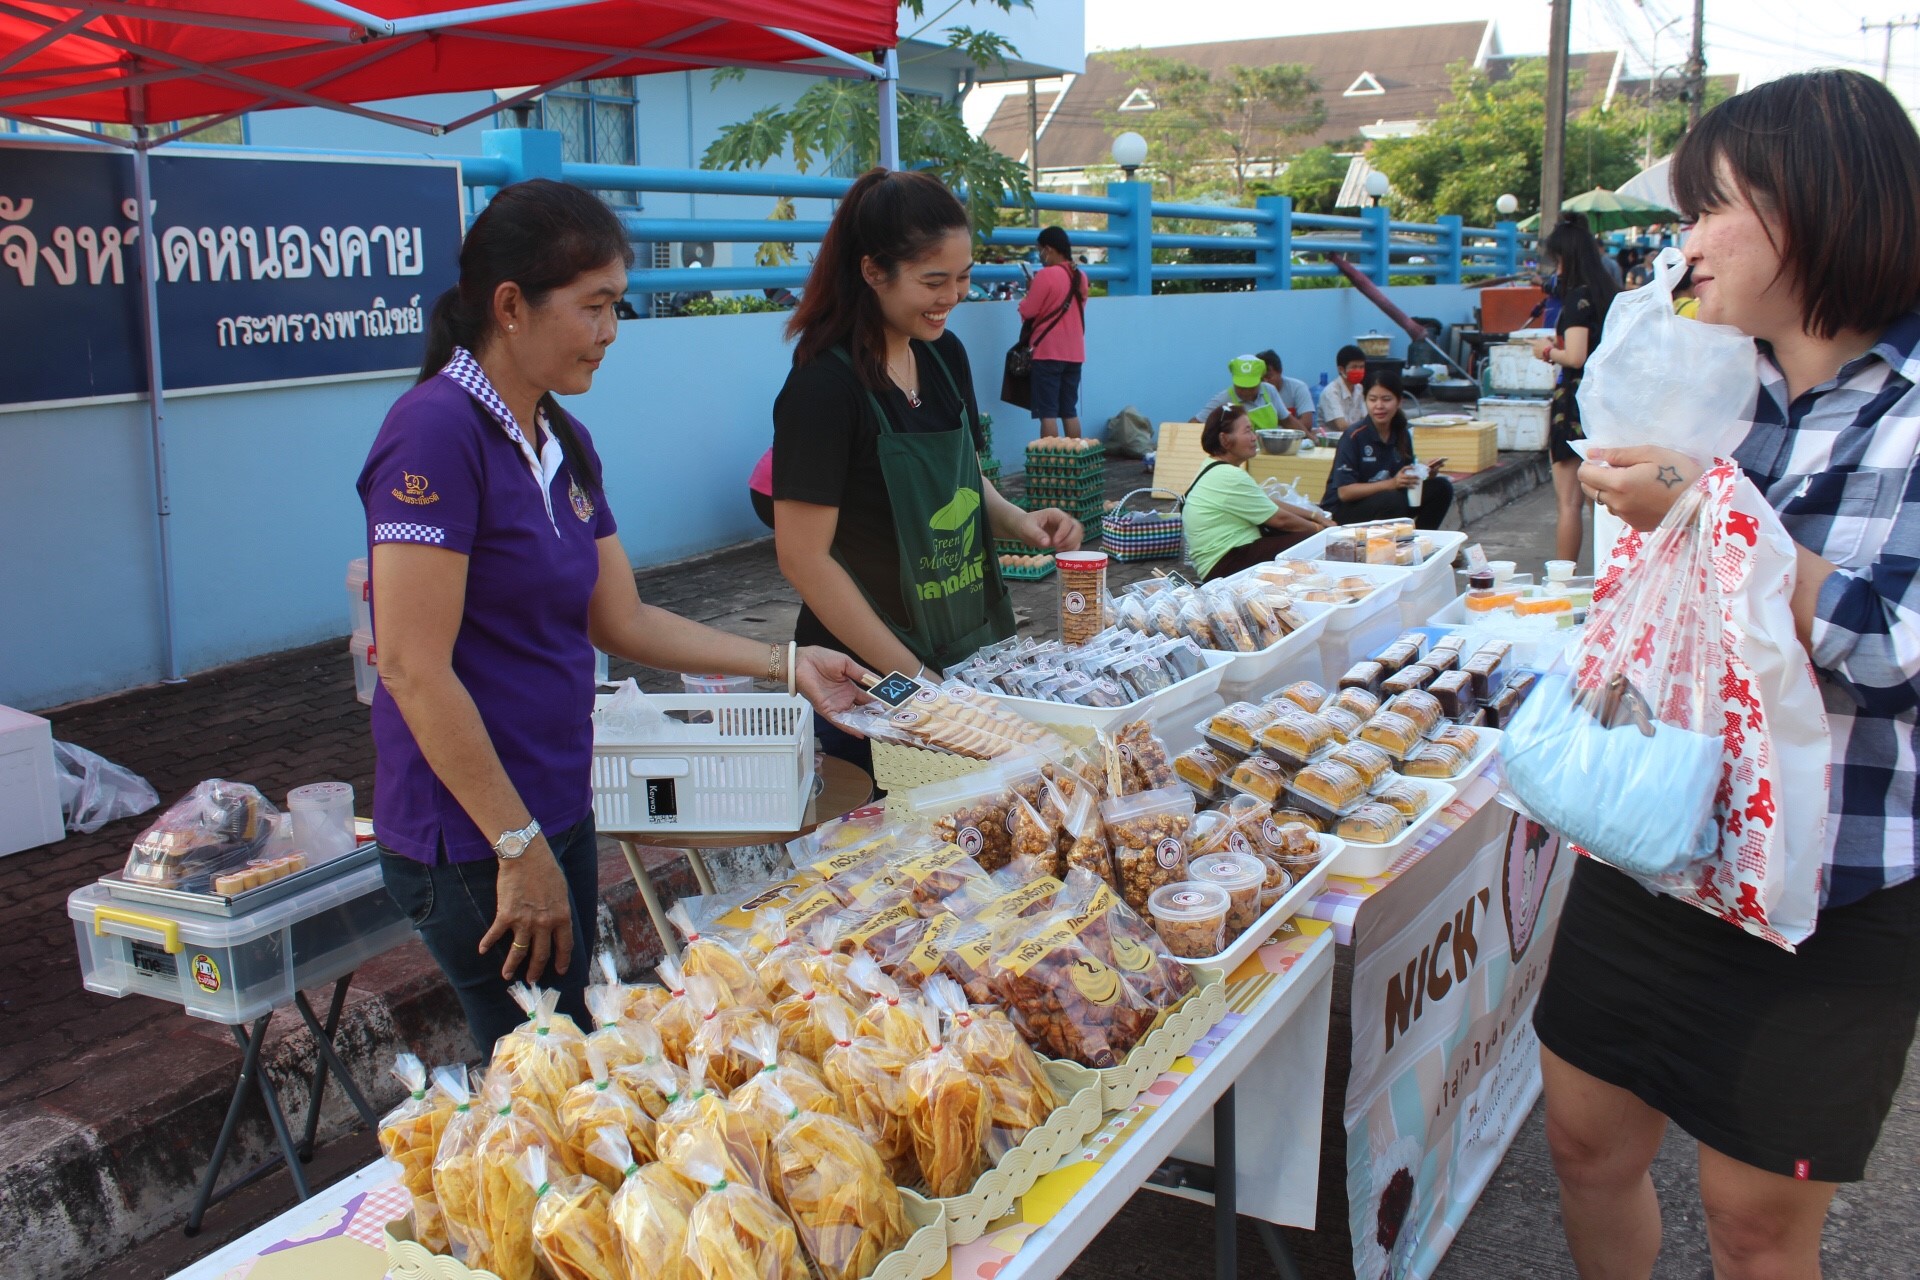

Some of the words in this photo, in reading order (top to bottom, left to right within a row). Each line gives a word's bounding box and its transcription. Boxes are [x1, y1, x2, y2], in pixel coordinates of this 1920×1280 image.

[217, 294, 425, 347] กระทรวงพาณิชย์
[648, 785, 658, 814] Keyway
[134, 955, 161, 973] Fine
[1096, 1052, 1111, 1066] OTOP
